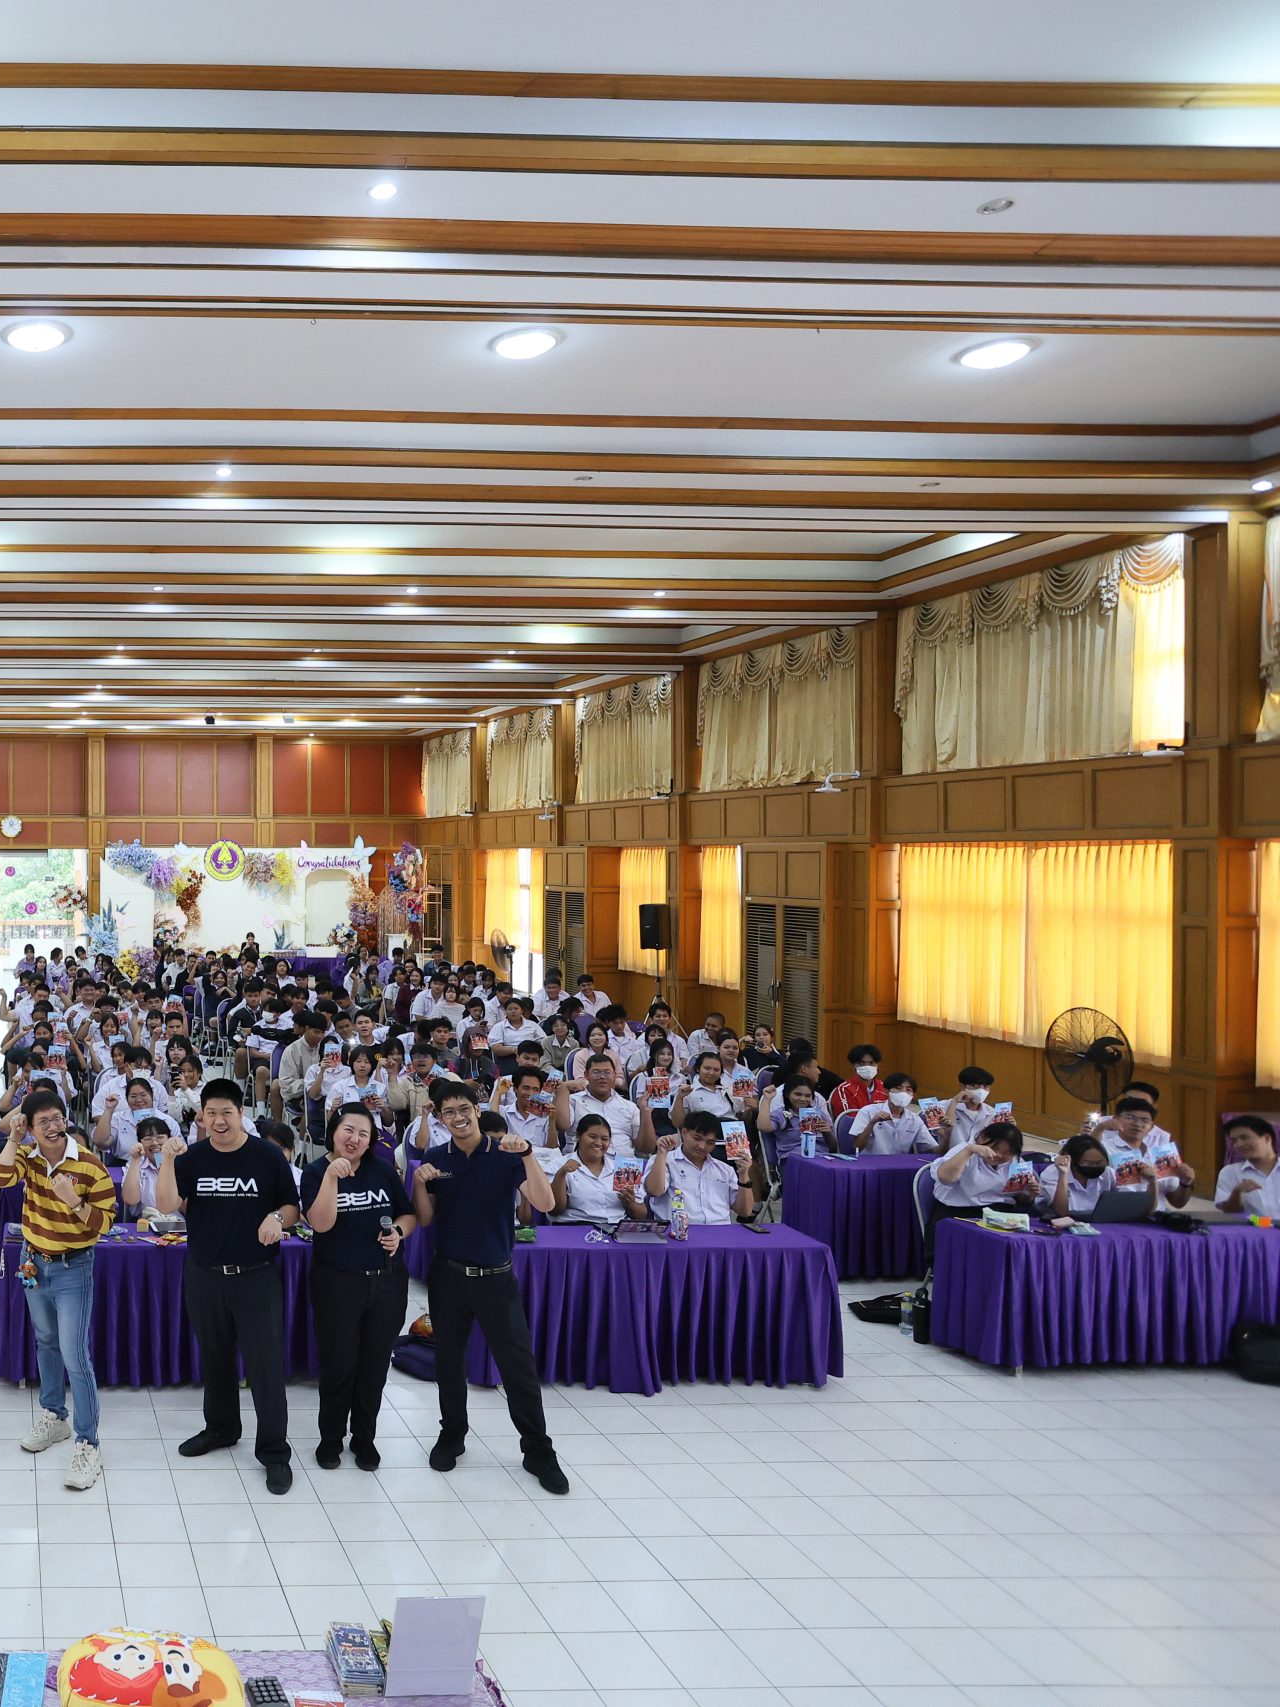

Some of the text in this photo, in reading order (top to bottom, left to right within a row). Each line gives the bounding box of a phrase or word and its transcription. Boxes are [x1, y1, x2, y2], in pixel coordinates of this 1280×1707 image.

[297, 855, 361, 871] Congratulations
[197, 1177, 259, 1192] BEM
[336, 1188, 390, 1208] BEM
